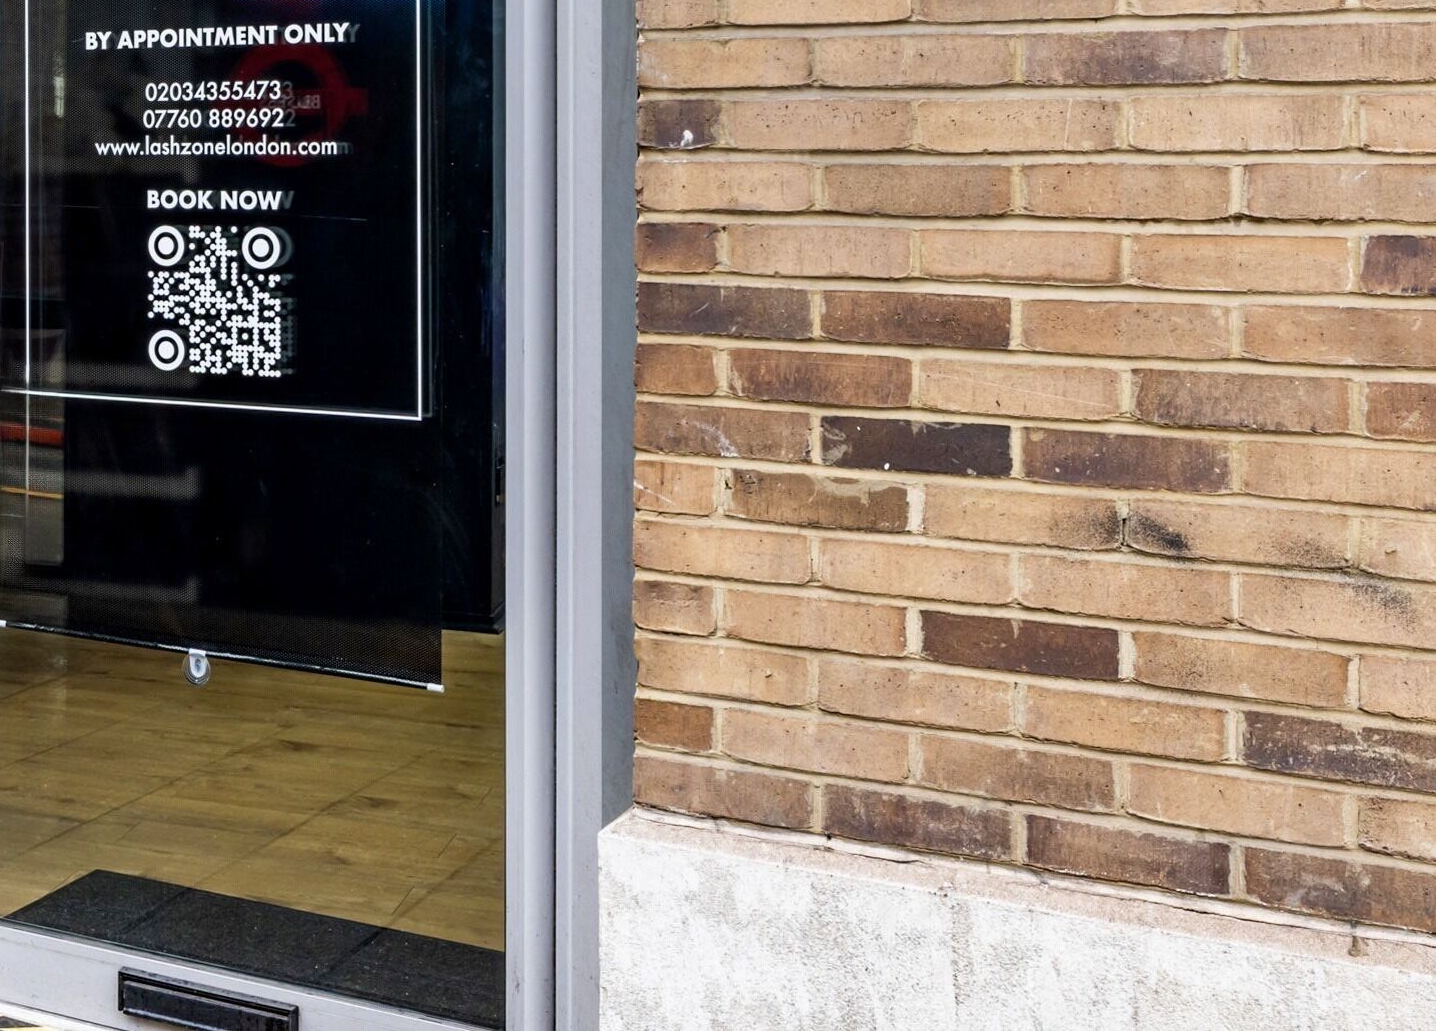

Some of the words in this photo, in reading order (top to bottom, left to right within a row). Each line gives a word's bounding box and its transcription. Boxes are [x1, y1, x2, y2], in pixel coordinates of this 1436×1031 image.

[85, 32, 113, 51] BY
[117, 26, 278, 50] APPOINTMENT
[284, 23, 350, 44] ONLY
[145, 80, 281, 102] 02034355473
[143, 110, 202, 130] 07760
[208, 108, 284, 128] 889692
[95, 134, 338, 157] www.lashzonelondon.com
[147, 190, 212, 210] BOOK
[220, 190, 282, 210] NOW
